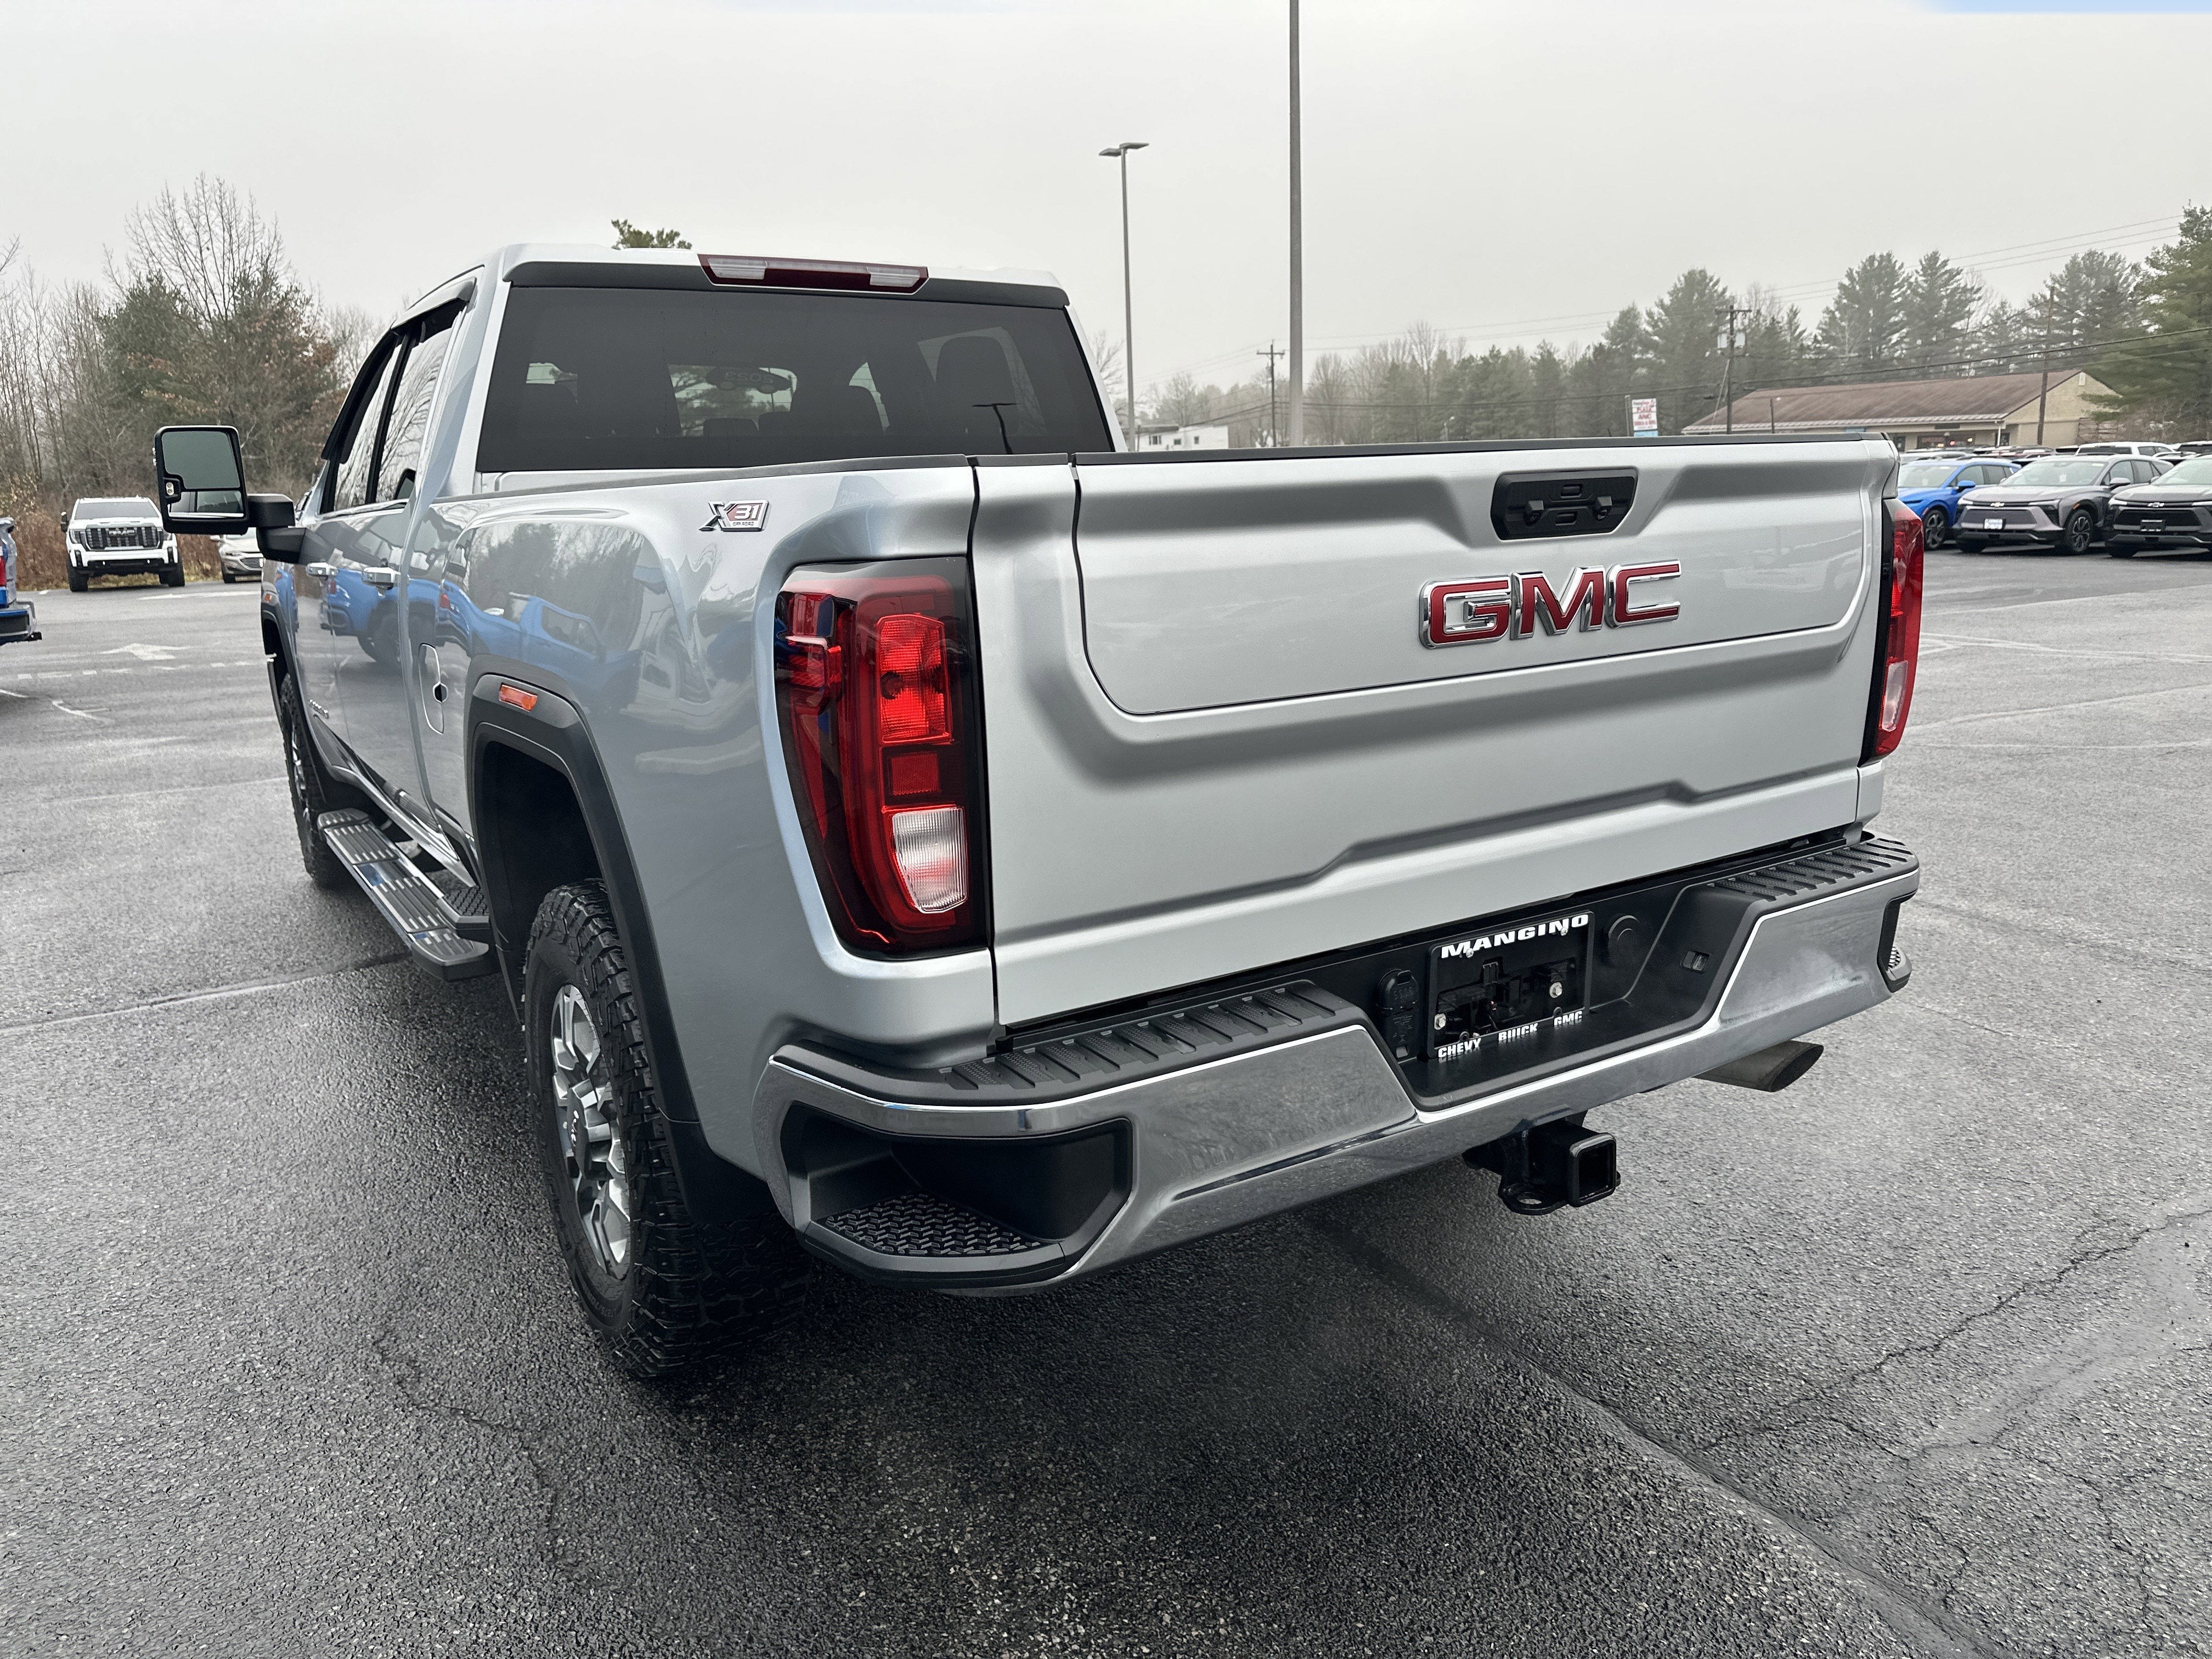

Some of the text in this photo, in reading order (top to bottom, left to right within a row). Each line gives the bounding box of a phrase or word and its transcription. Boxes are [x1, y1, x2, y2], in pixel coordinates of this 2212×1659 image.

[699, 500, 769, 531] X31
[1419, 558, 1681, 648] GMC
[1441, 914, 1588, 958] MANGINO
[1438, 1011, 1582, 1058] CHEVY BUICK GMC
